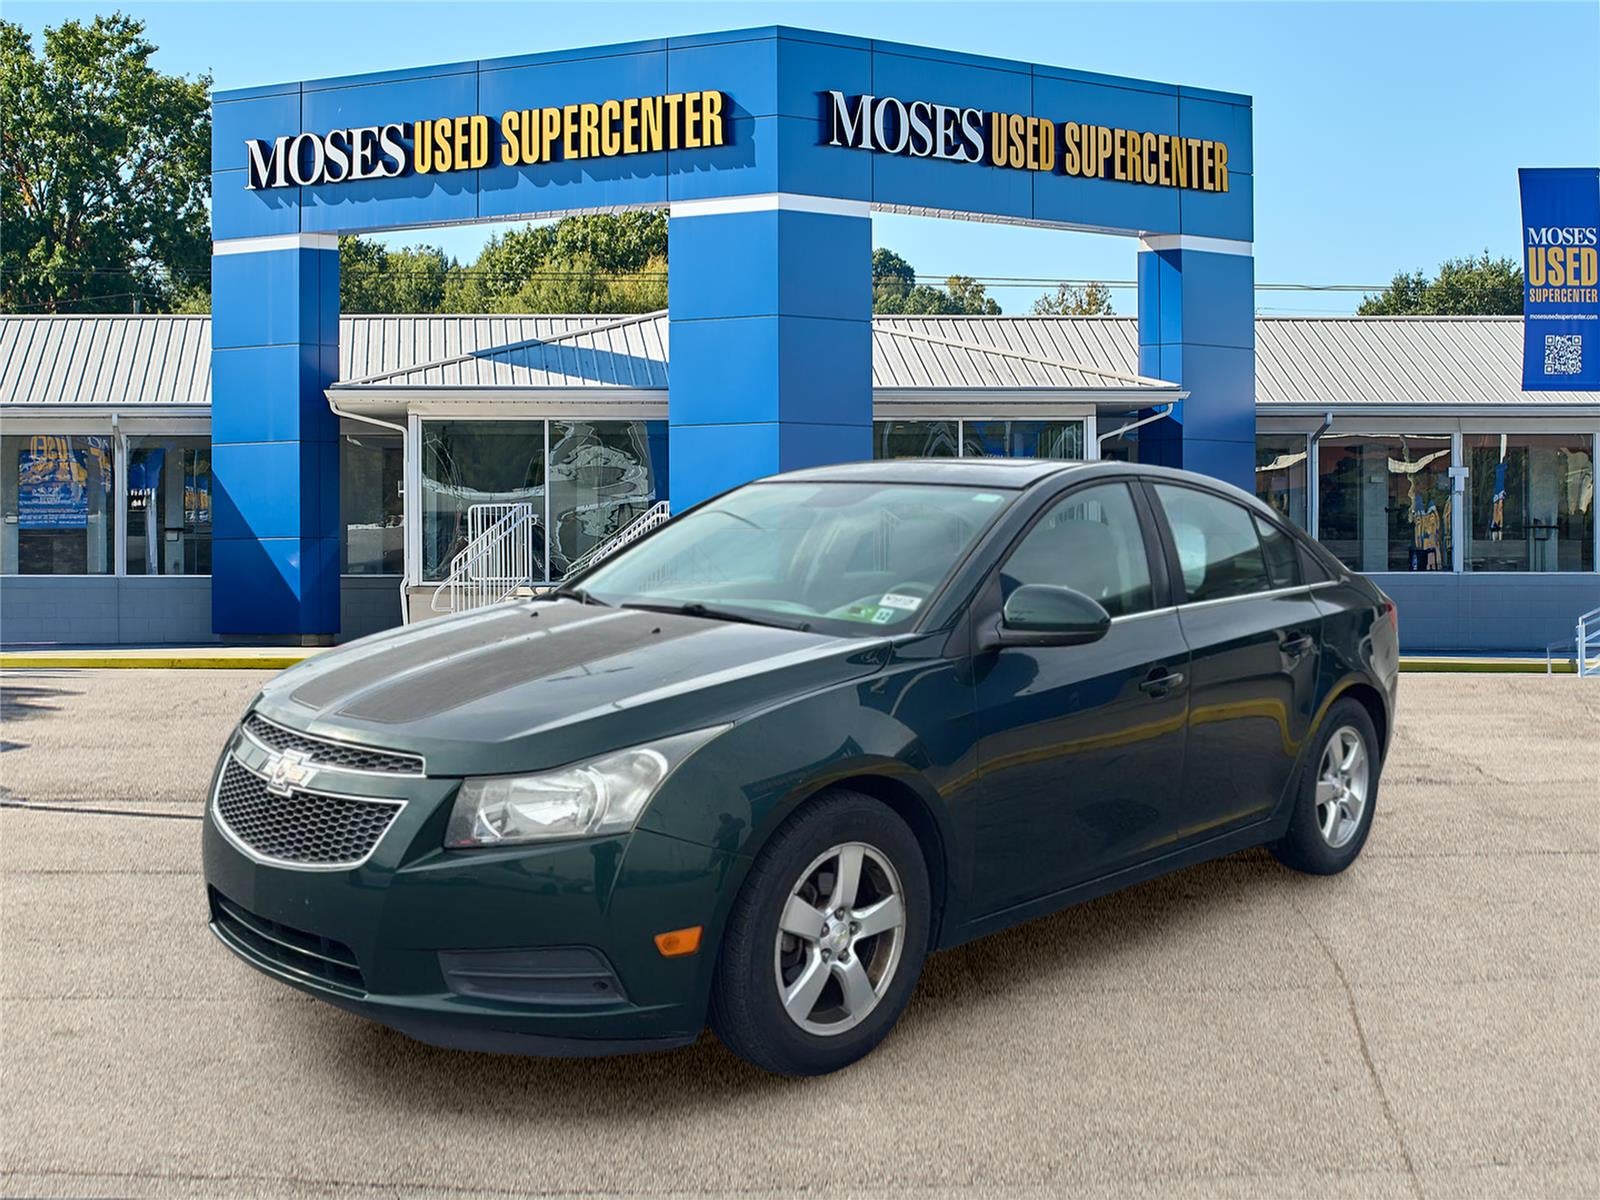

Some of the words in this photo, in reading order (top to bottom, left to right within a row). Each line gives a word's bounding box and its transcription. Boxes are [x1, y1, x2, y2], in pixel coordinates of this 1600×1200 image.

[244, 123, 407, 190] MOSES
[414, 114, 489, 174] USED
[501, 90, 724, 166] SUPERCENTER
[827, 90, 985, 163] MOSES
[991, 112, 1055, 172] USED
[1064, 121, 1229, 193] SUPERCENTER
[1528, 227, 1597, 246] MOSES
[1528, 247, 1598, 287] USED
[1529, 288, 1598, 303] SUPERCENTER
[1529, 313, 1598, 321] mosesusedsupercenter.com
